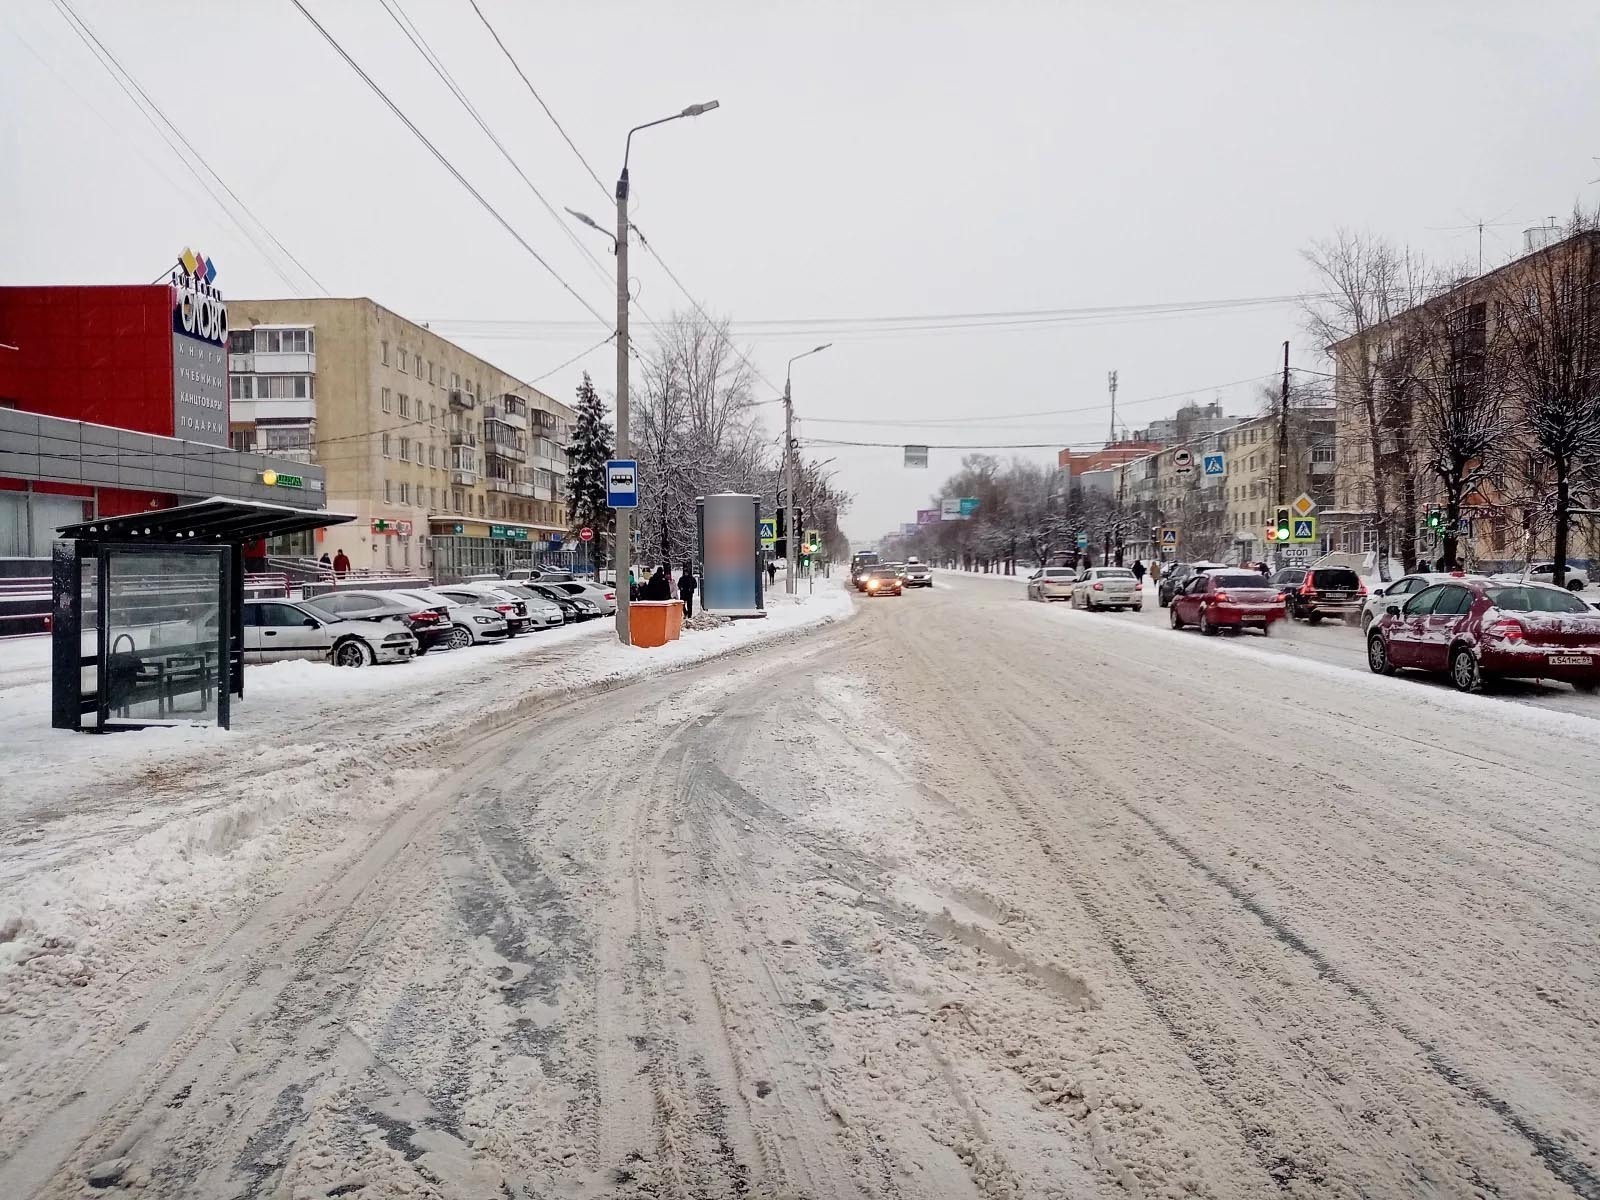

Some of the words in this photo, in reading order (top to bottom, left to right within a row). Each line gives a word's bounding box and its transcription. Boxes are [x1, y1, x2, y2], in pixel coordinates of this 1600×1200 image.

[181, 289, 228, 344] СЛОВО
[179, 343, 222, 365] КНИГИ
[180, 367, 223, 389] УЧЕБНИКИ
[180, 391, 223, 411] КАНЦТОВАРЫ
[181, 415, 223, 434] ПОДАРКИ
[1285, 549, 1308, 557] СТОП
